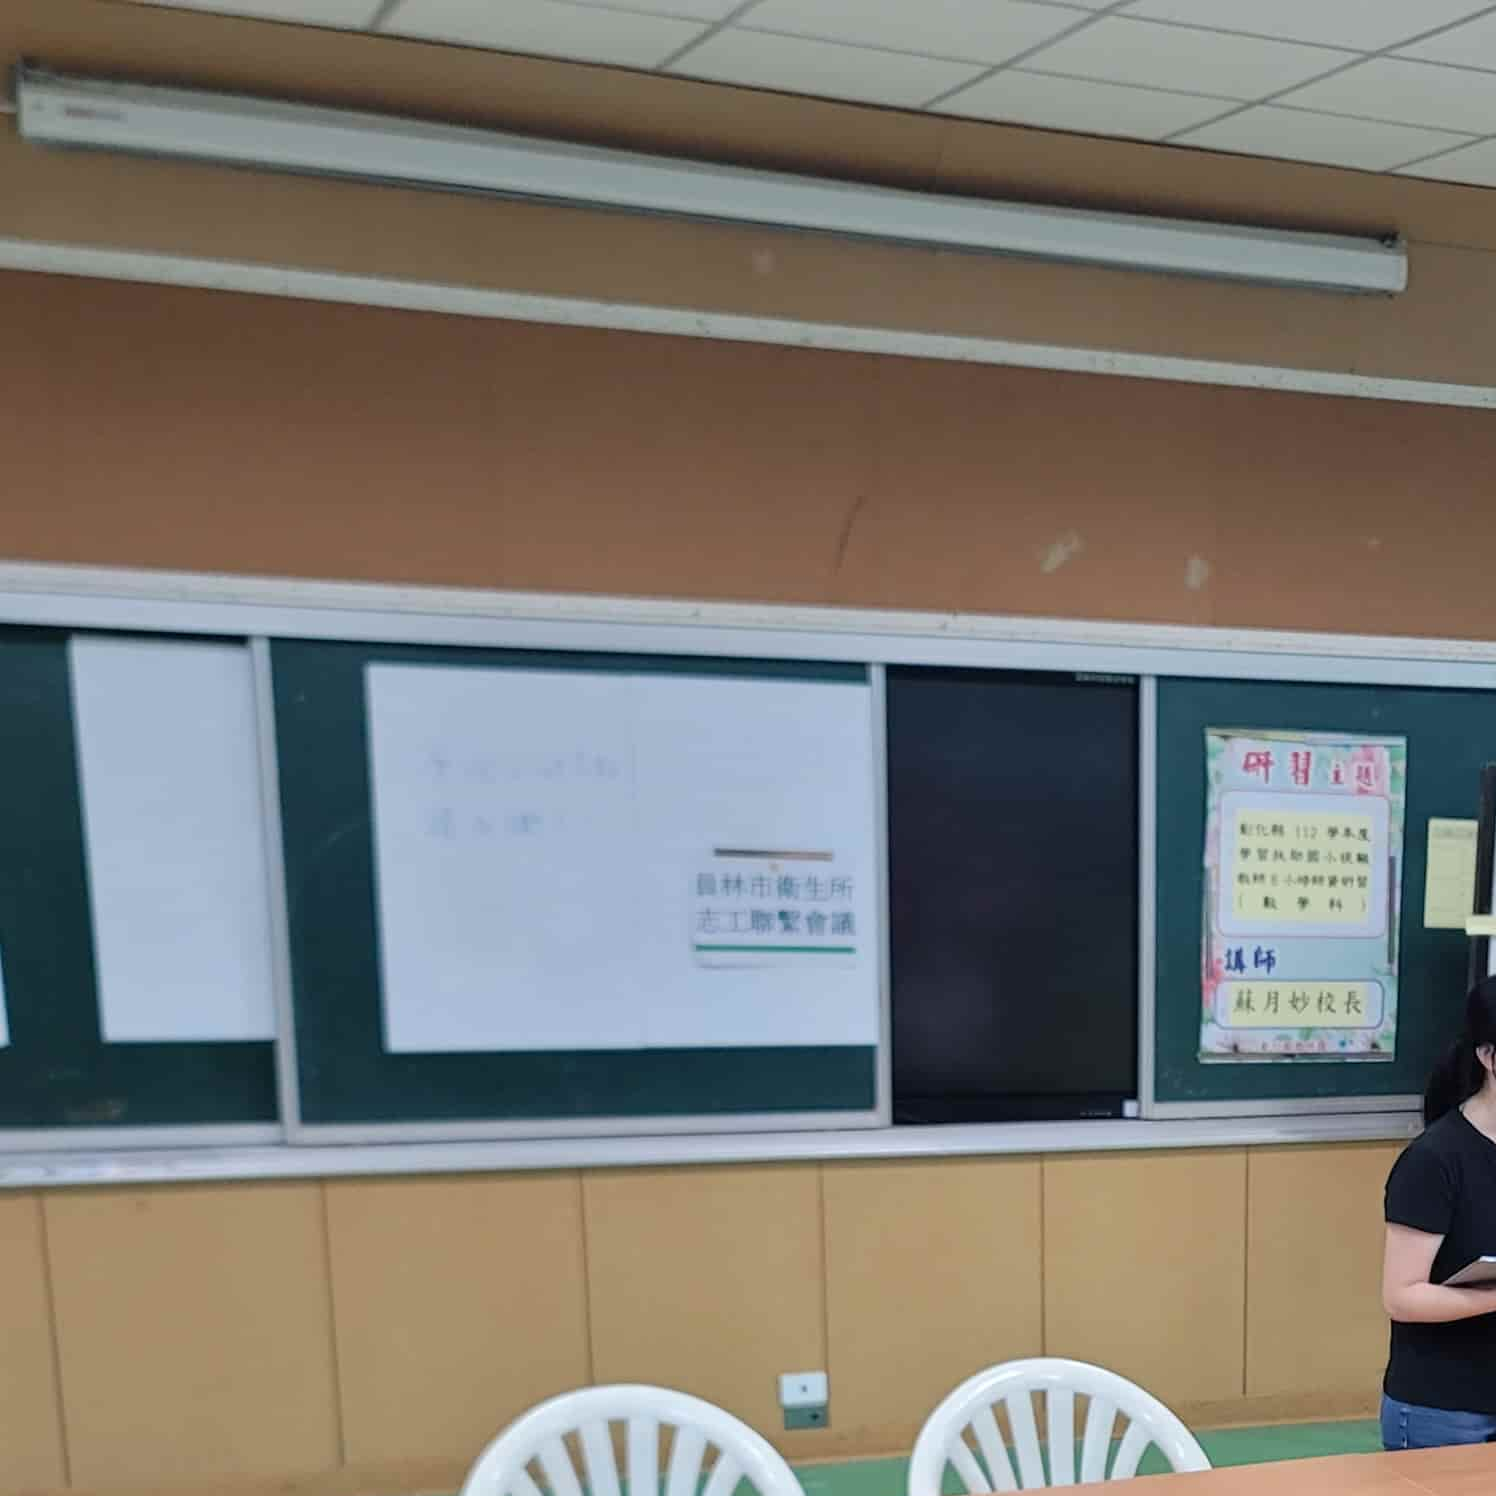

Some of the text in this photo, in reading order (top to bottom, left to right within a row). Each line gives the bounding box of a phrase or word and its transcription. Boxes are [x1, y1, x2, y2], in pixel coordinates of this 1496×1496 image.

[1224, 946, 1277, 974] 講師
[1233, 988, 1363, 1015] 蘇月妙校長
